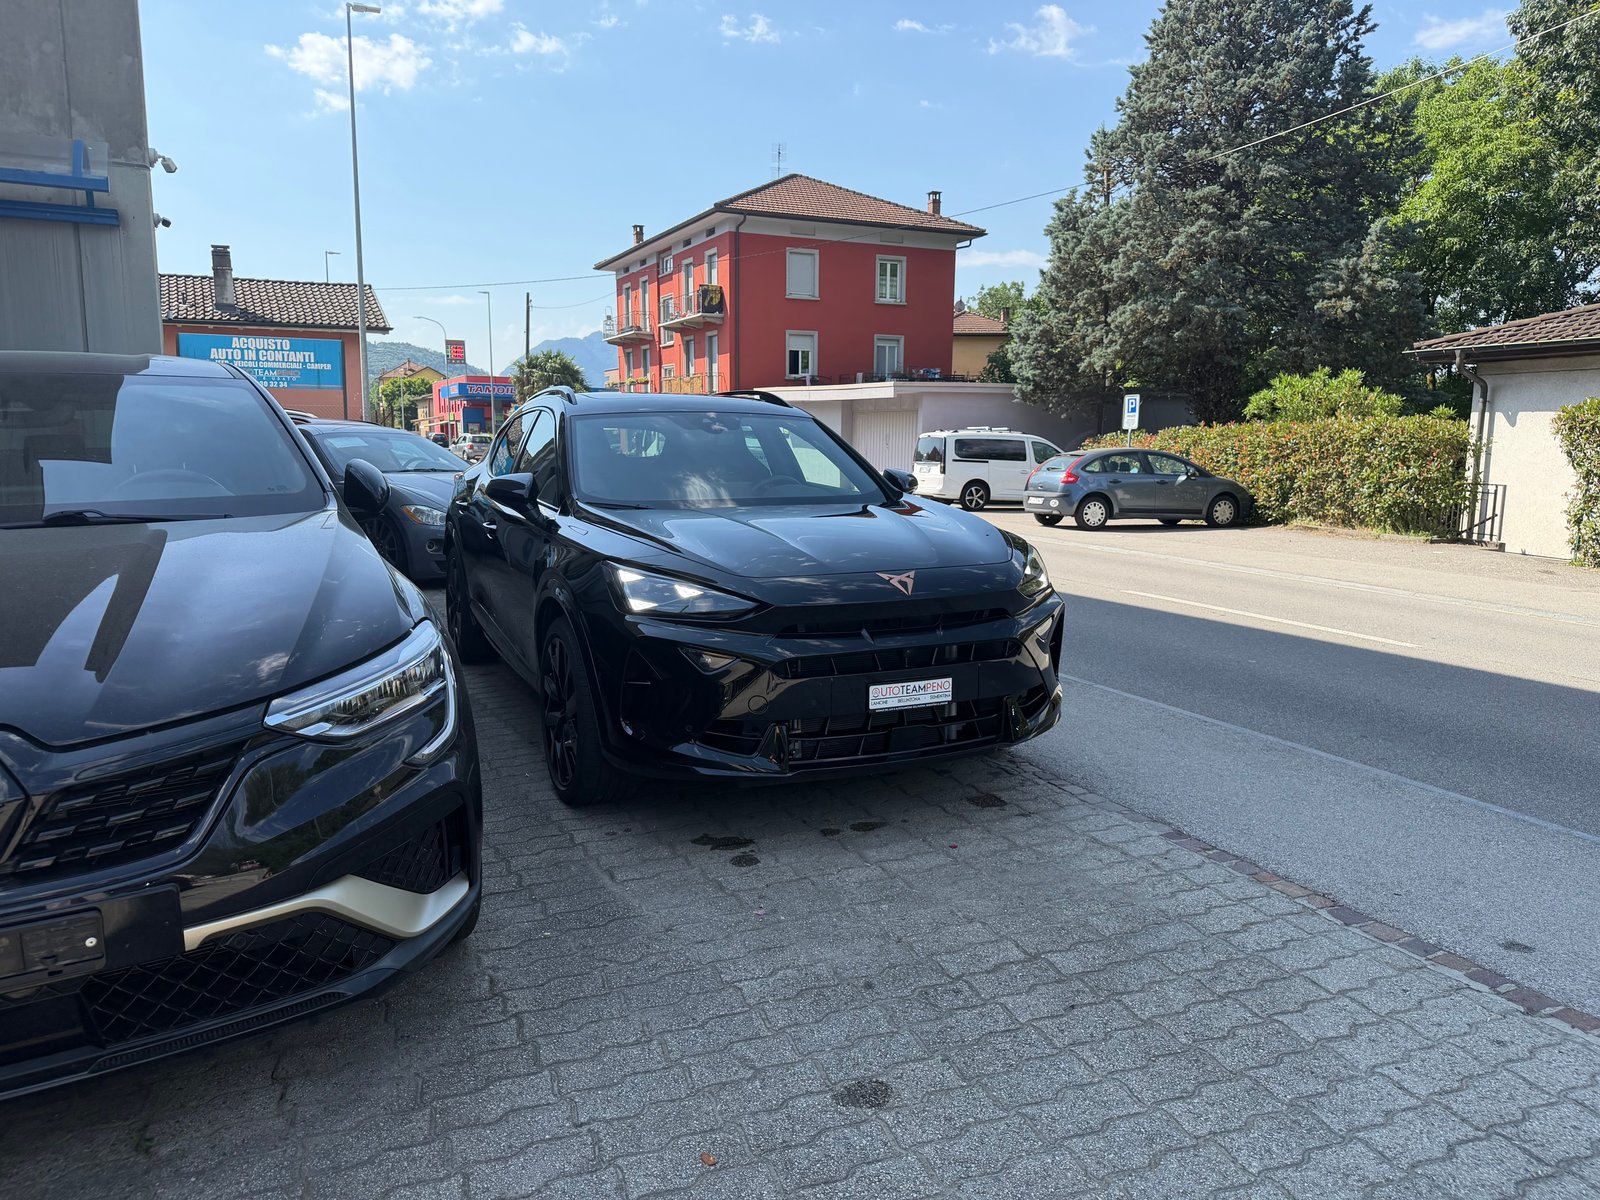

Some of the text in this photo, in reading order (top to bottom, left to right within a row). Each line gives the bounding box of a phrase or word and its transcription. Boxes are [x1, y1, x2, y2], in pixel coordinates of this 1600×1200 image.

[232, 337, 290, 350] ACQUISTO
[210, 348, 314, 362] AUTO IN CONTANTI
[233, 360, 258, 368] VEICOLI
[467, 384, 516, 394] TAMOIL
[1128, 400, 1136, 412] P
